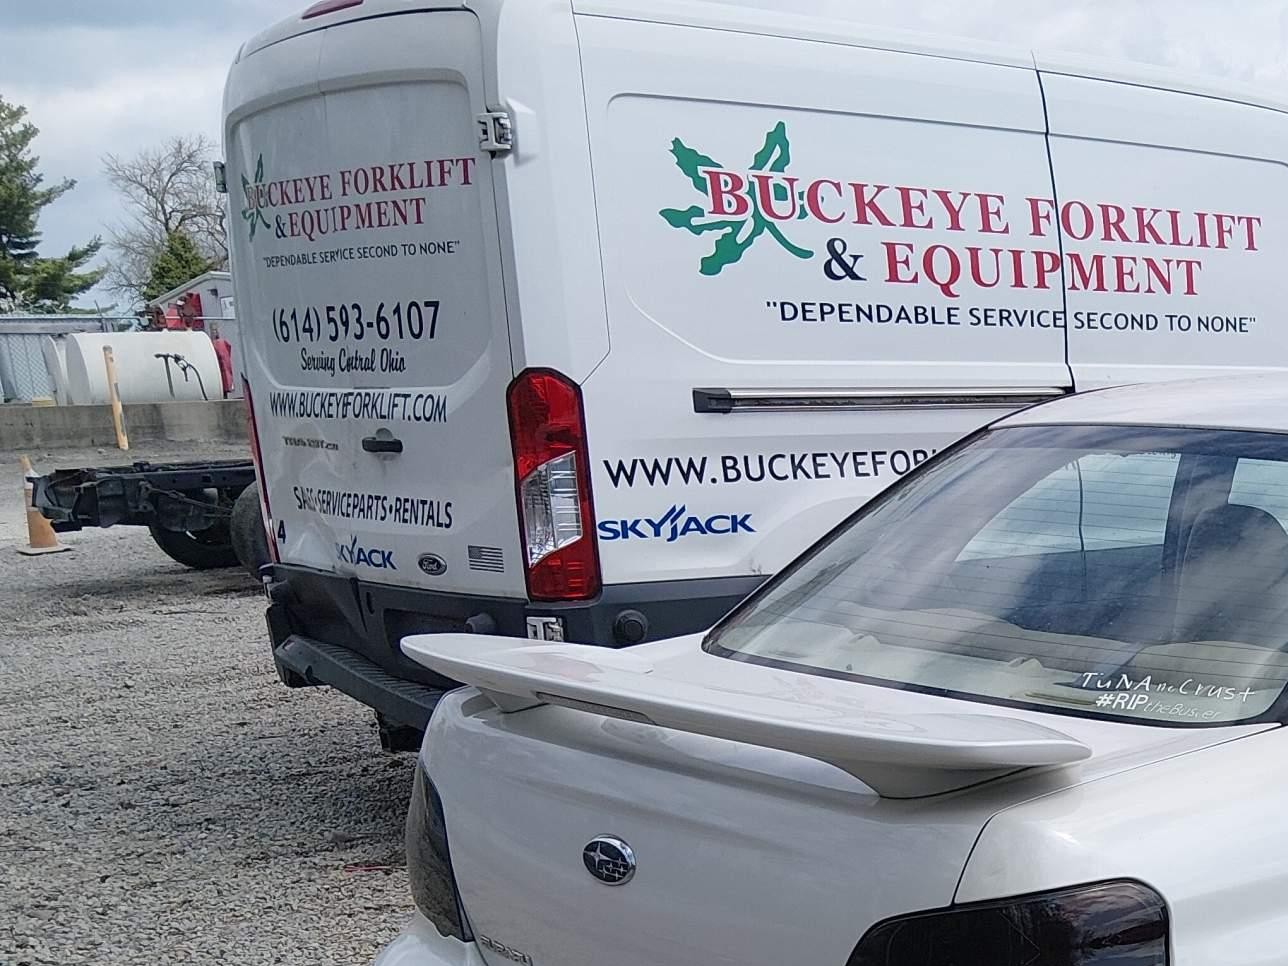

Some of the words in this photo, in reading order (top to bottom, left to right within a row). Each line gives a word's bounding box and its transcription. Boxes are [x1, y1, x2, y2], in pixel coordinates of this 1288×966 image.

[248, 174, 333, 212] BUCKEYE
[339, 157, 476, 197] FORKLIFT
[275, 214, 287, 240] &
[288, 197, 426, 242] EQUIPMENT
[702, 169, 1007, 236] BUCKEYE
[1028, 197, 1263, 252] FORKLIFT
[319, 247, 355, 264] SERVICE
[357, 244, 399, 259] SECOND
[401, 243, 417, 256] TO
[419, 240, 461, 255] NONE"
[822, 237, 867, 282] &
[882, 240, 1203, 299] EQUIPMENT
[272, 306, 321, 343] (614)
[325, 300, 441, 342] 593-6107
[765, 301, 962, 327] "DEPENDABLE
[968, 307, 1066, 329] SERVICE
[1073, 311, 1159, 332] SECOND
[1165, 313, 1192, 332] TO
[1197, 315, 1257, 333] NONE"
[300, 346, 336, 377] Serving
[380, 348, 407, 373] Ohio
[269, 391, 448, 424] WWW.BUCKEYEFORKLIFT.COM
[393, 496, 453, 530] RENTALS
[597, 504, 758, 543] SKYJACK
